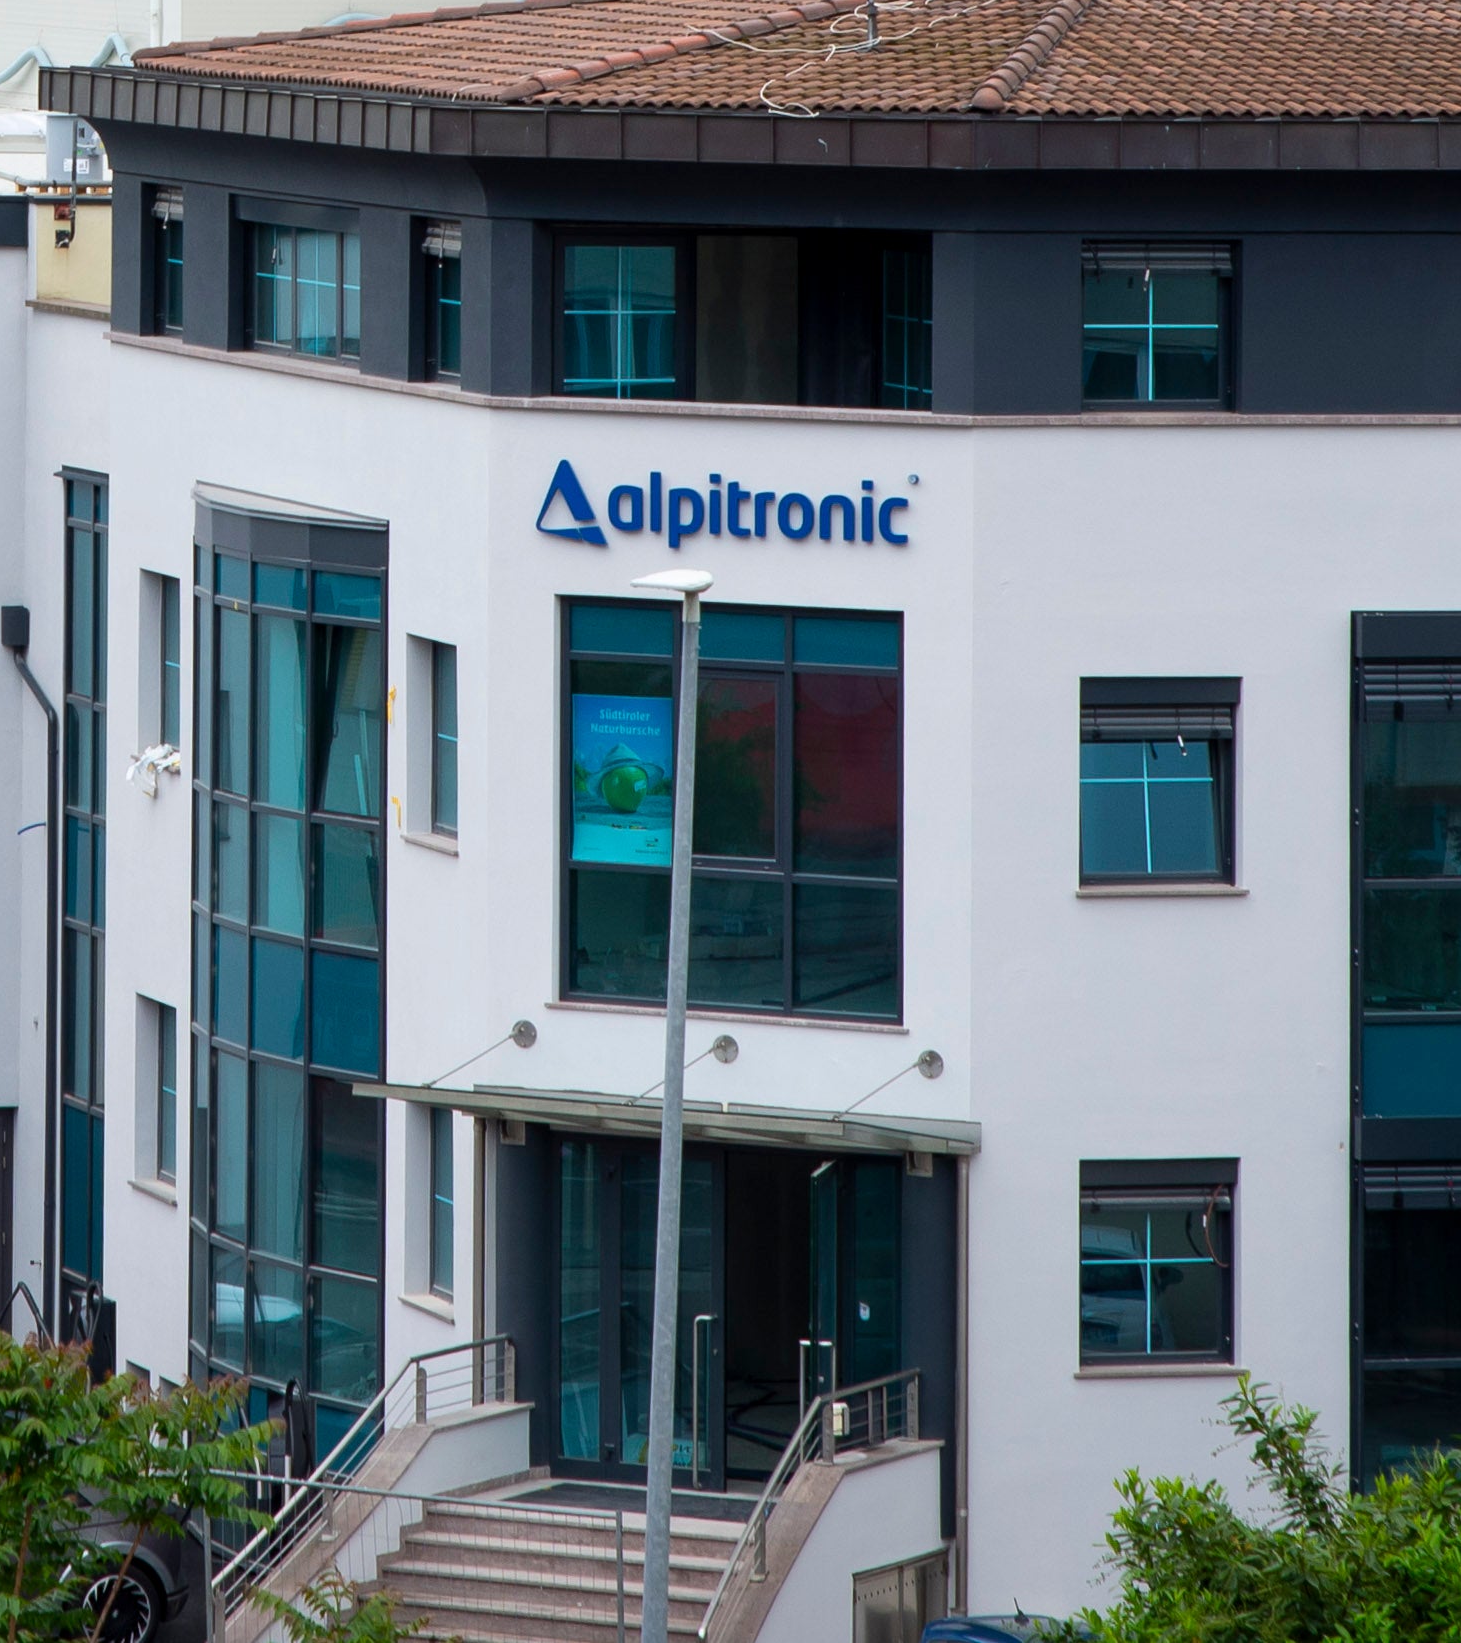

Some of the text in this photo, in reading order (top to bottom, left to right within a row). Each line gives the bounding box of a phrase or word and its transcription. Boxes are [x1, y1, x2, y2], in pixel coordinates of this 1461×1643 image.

[607, 470, 909, 550] alpitronic
[599, 708, 651, 721] Südtiroler
[590, 722, 661, 736] Naturbursche
